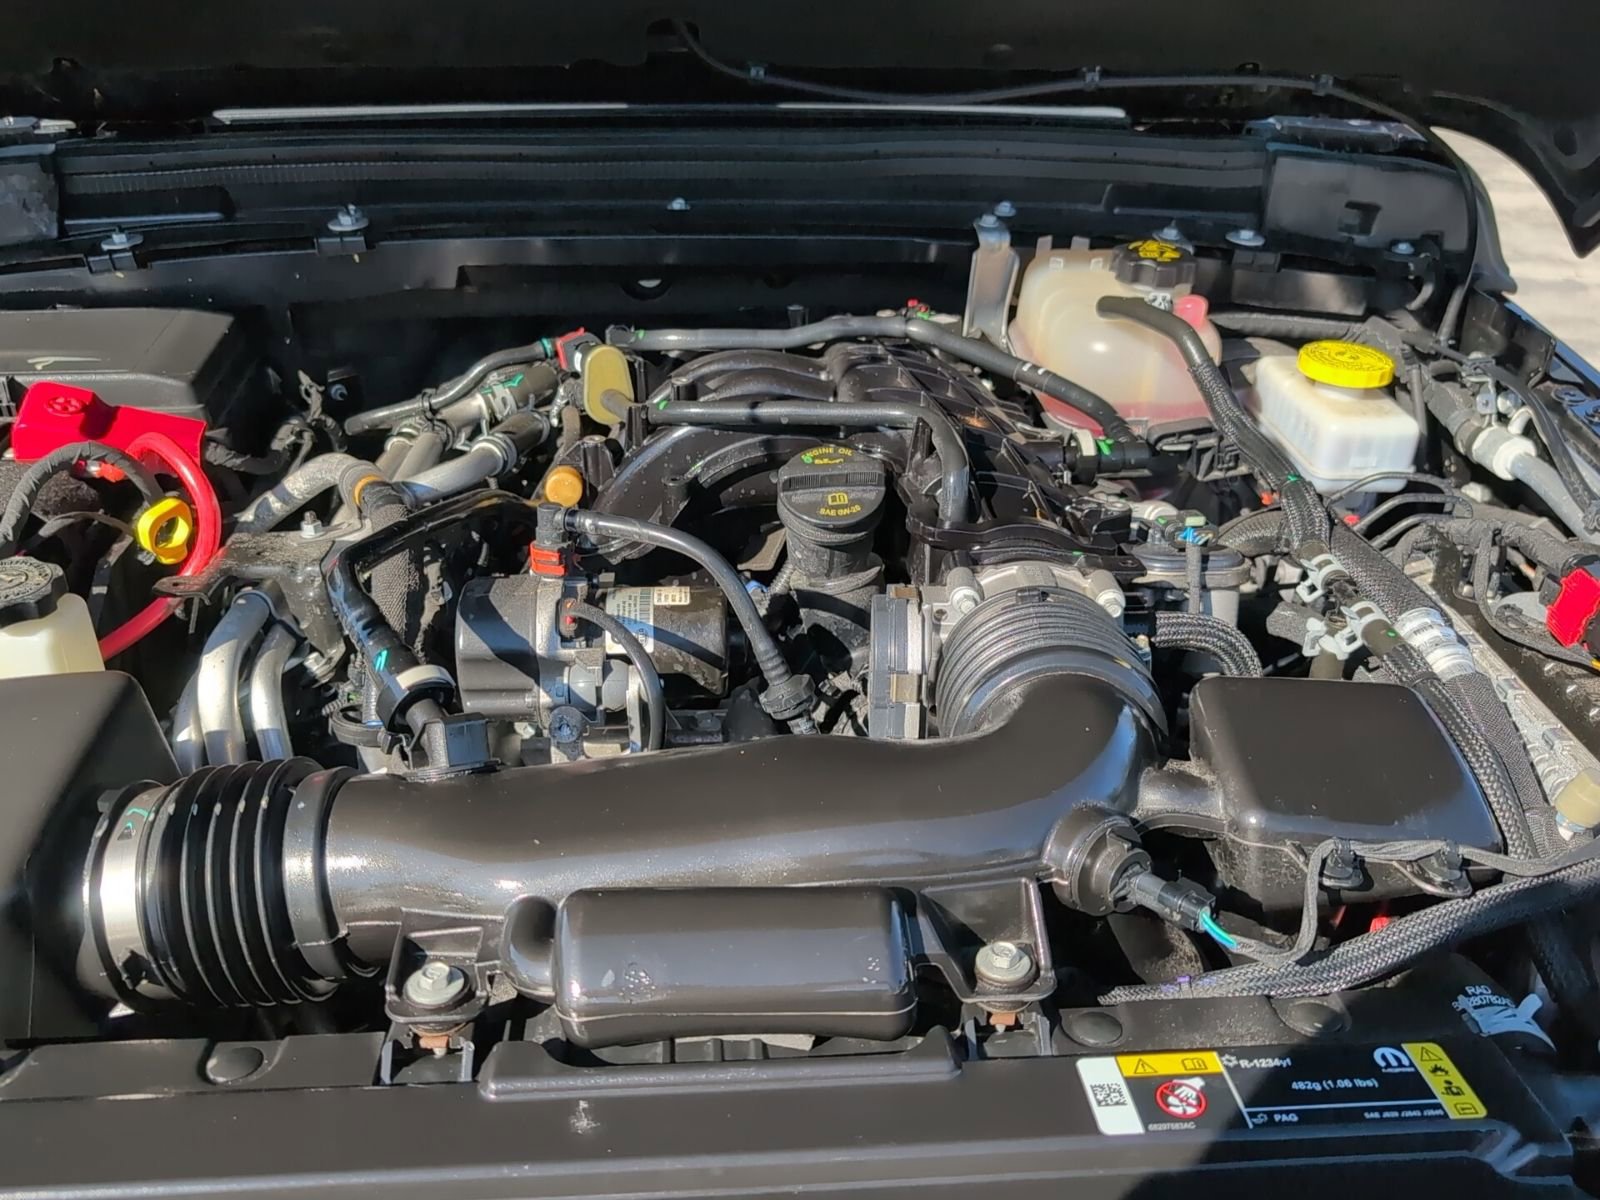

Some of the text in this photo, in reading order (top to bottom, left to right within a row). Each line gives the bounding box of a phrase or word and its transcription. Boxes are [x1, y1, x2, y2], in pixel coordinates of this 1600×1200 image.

[838, 448, 853, 457] OIL
[820, 507, 837, 516] SAE
[1465, 985, 1492, 996] RAD
[1292, 1081, 1322, 1091] 482g
[1354, 1078, 1379, 1089] lbs)
[1273, 1112, 1299, 1122] PAG
